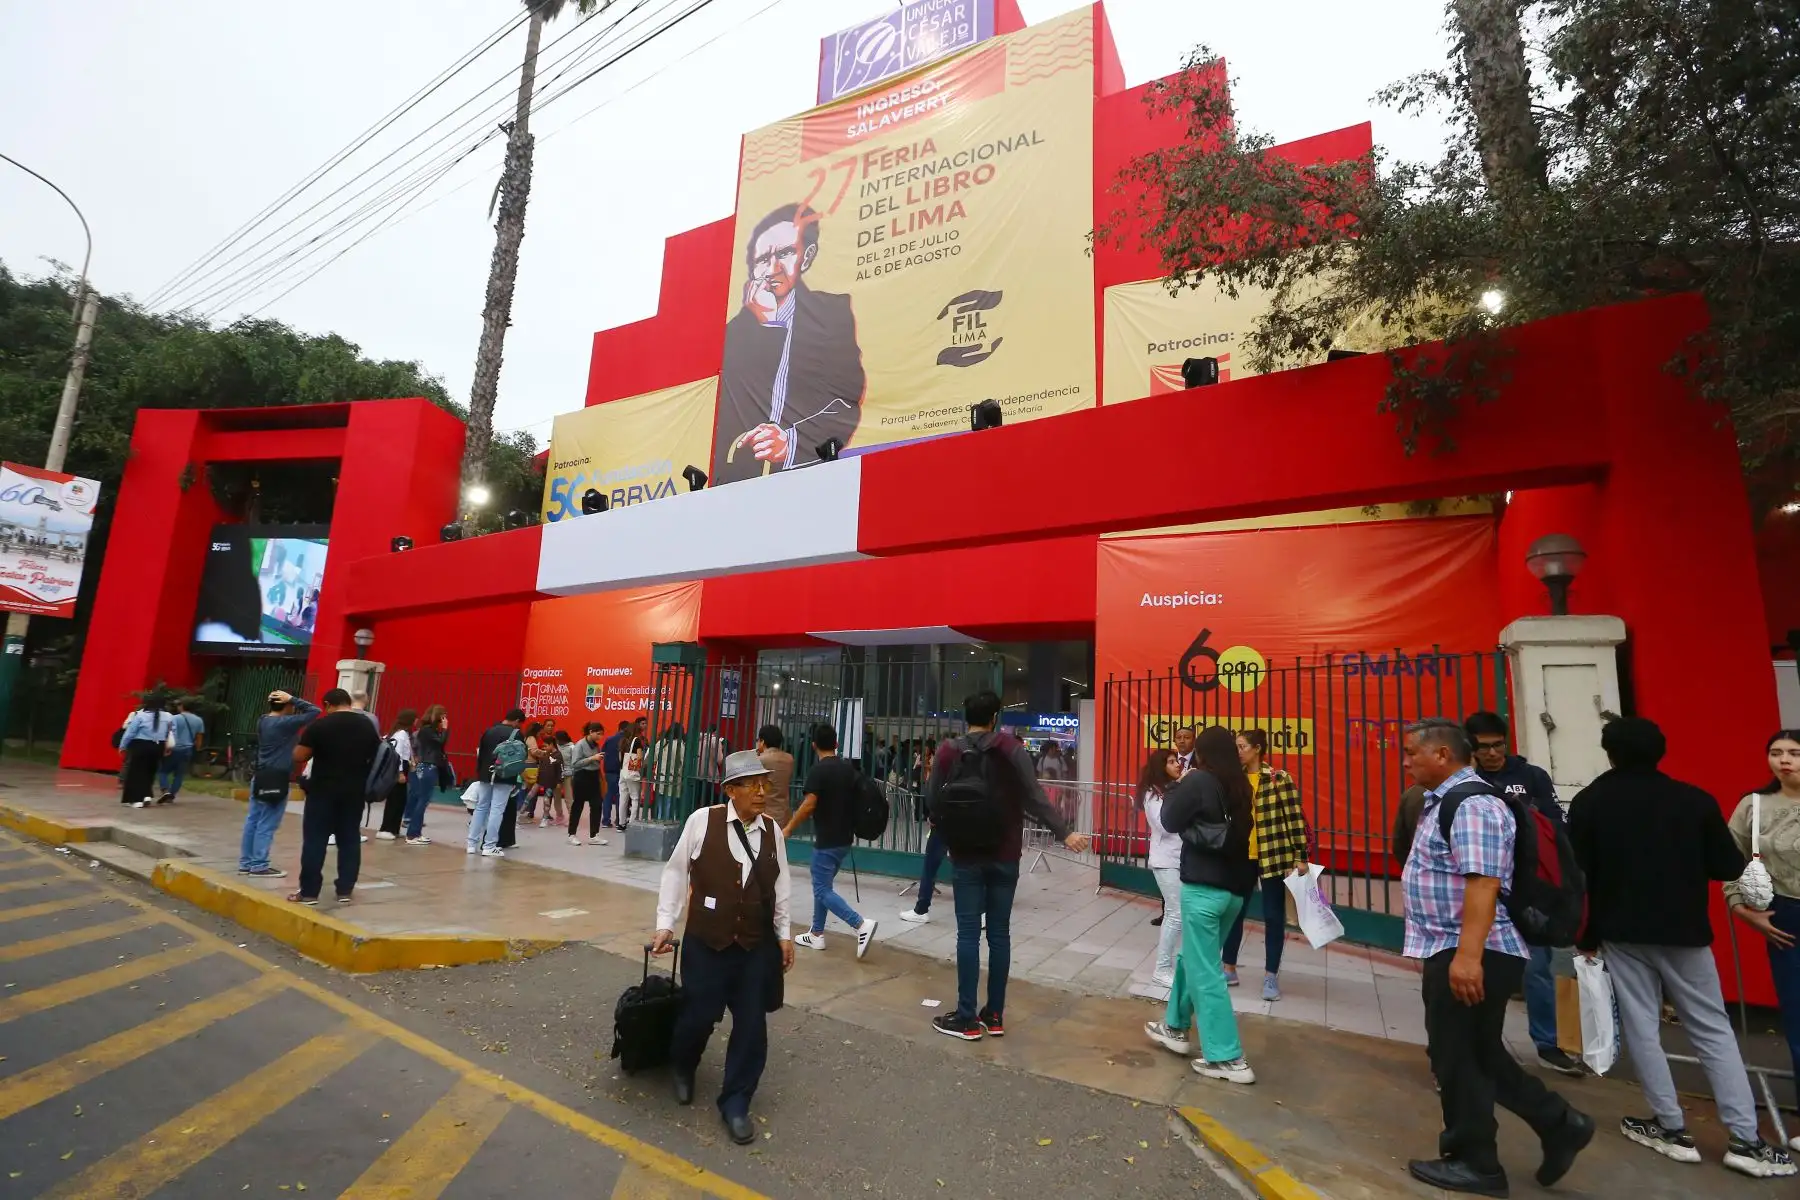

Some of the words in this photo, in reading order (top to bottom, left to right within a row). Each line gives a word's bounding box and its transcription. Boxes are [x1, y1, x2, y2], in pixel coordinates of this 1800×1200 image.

[908, 4, 966, 40] CÉSAR
[906, 23, 969, 60] VAEJO
[846, 93, 952, 138] SALAVERRY
[860, 129, 1046, 198] INTERNACIONAL
[793, 155, 858, 227] 27
[862, 138, 938, 180] FERIA
[858, 197, 900, 221] DEL
[906, 163, 996, 205] LIBRO
[857, 225, 886, 248] DE
[891, 200, 967, 238] LIMA
[857, 253, 879, 266] DEL
[883, 247, 896, 259] 21
[899, 242, 916, 254] DE
[919, 230, 960, 249] JULIO
[855, 270, 871, 282] AL
[874, 265, 882, 276] 6
[884, 260, 902, 273] DE
[904, 245, 961, 268] AGOSTO
[952, 312, 987, 333] FIL
[952, 329, 987, 345] LIMA
[1147, 332, 1235, 355] Patrocina:
[881, 414, 917, 425] Parque
[998, 385, 1080, 407] ndependencia
[1018, 405, 1043, 416] María
[553, 457, 592, 471] Patrocina:
[1140, 591, 1223, 609] Auspicia:
[523, 667, 563, 679] Organiza:
[587, 667, 632, 677] Promueve:
[1343, 652, 1461, 677] SMART
[538, 706, 549, 716] DEL
[604, 698, 636, 711] Jesús
[638, 698, 673, 711] Maía
